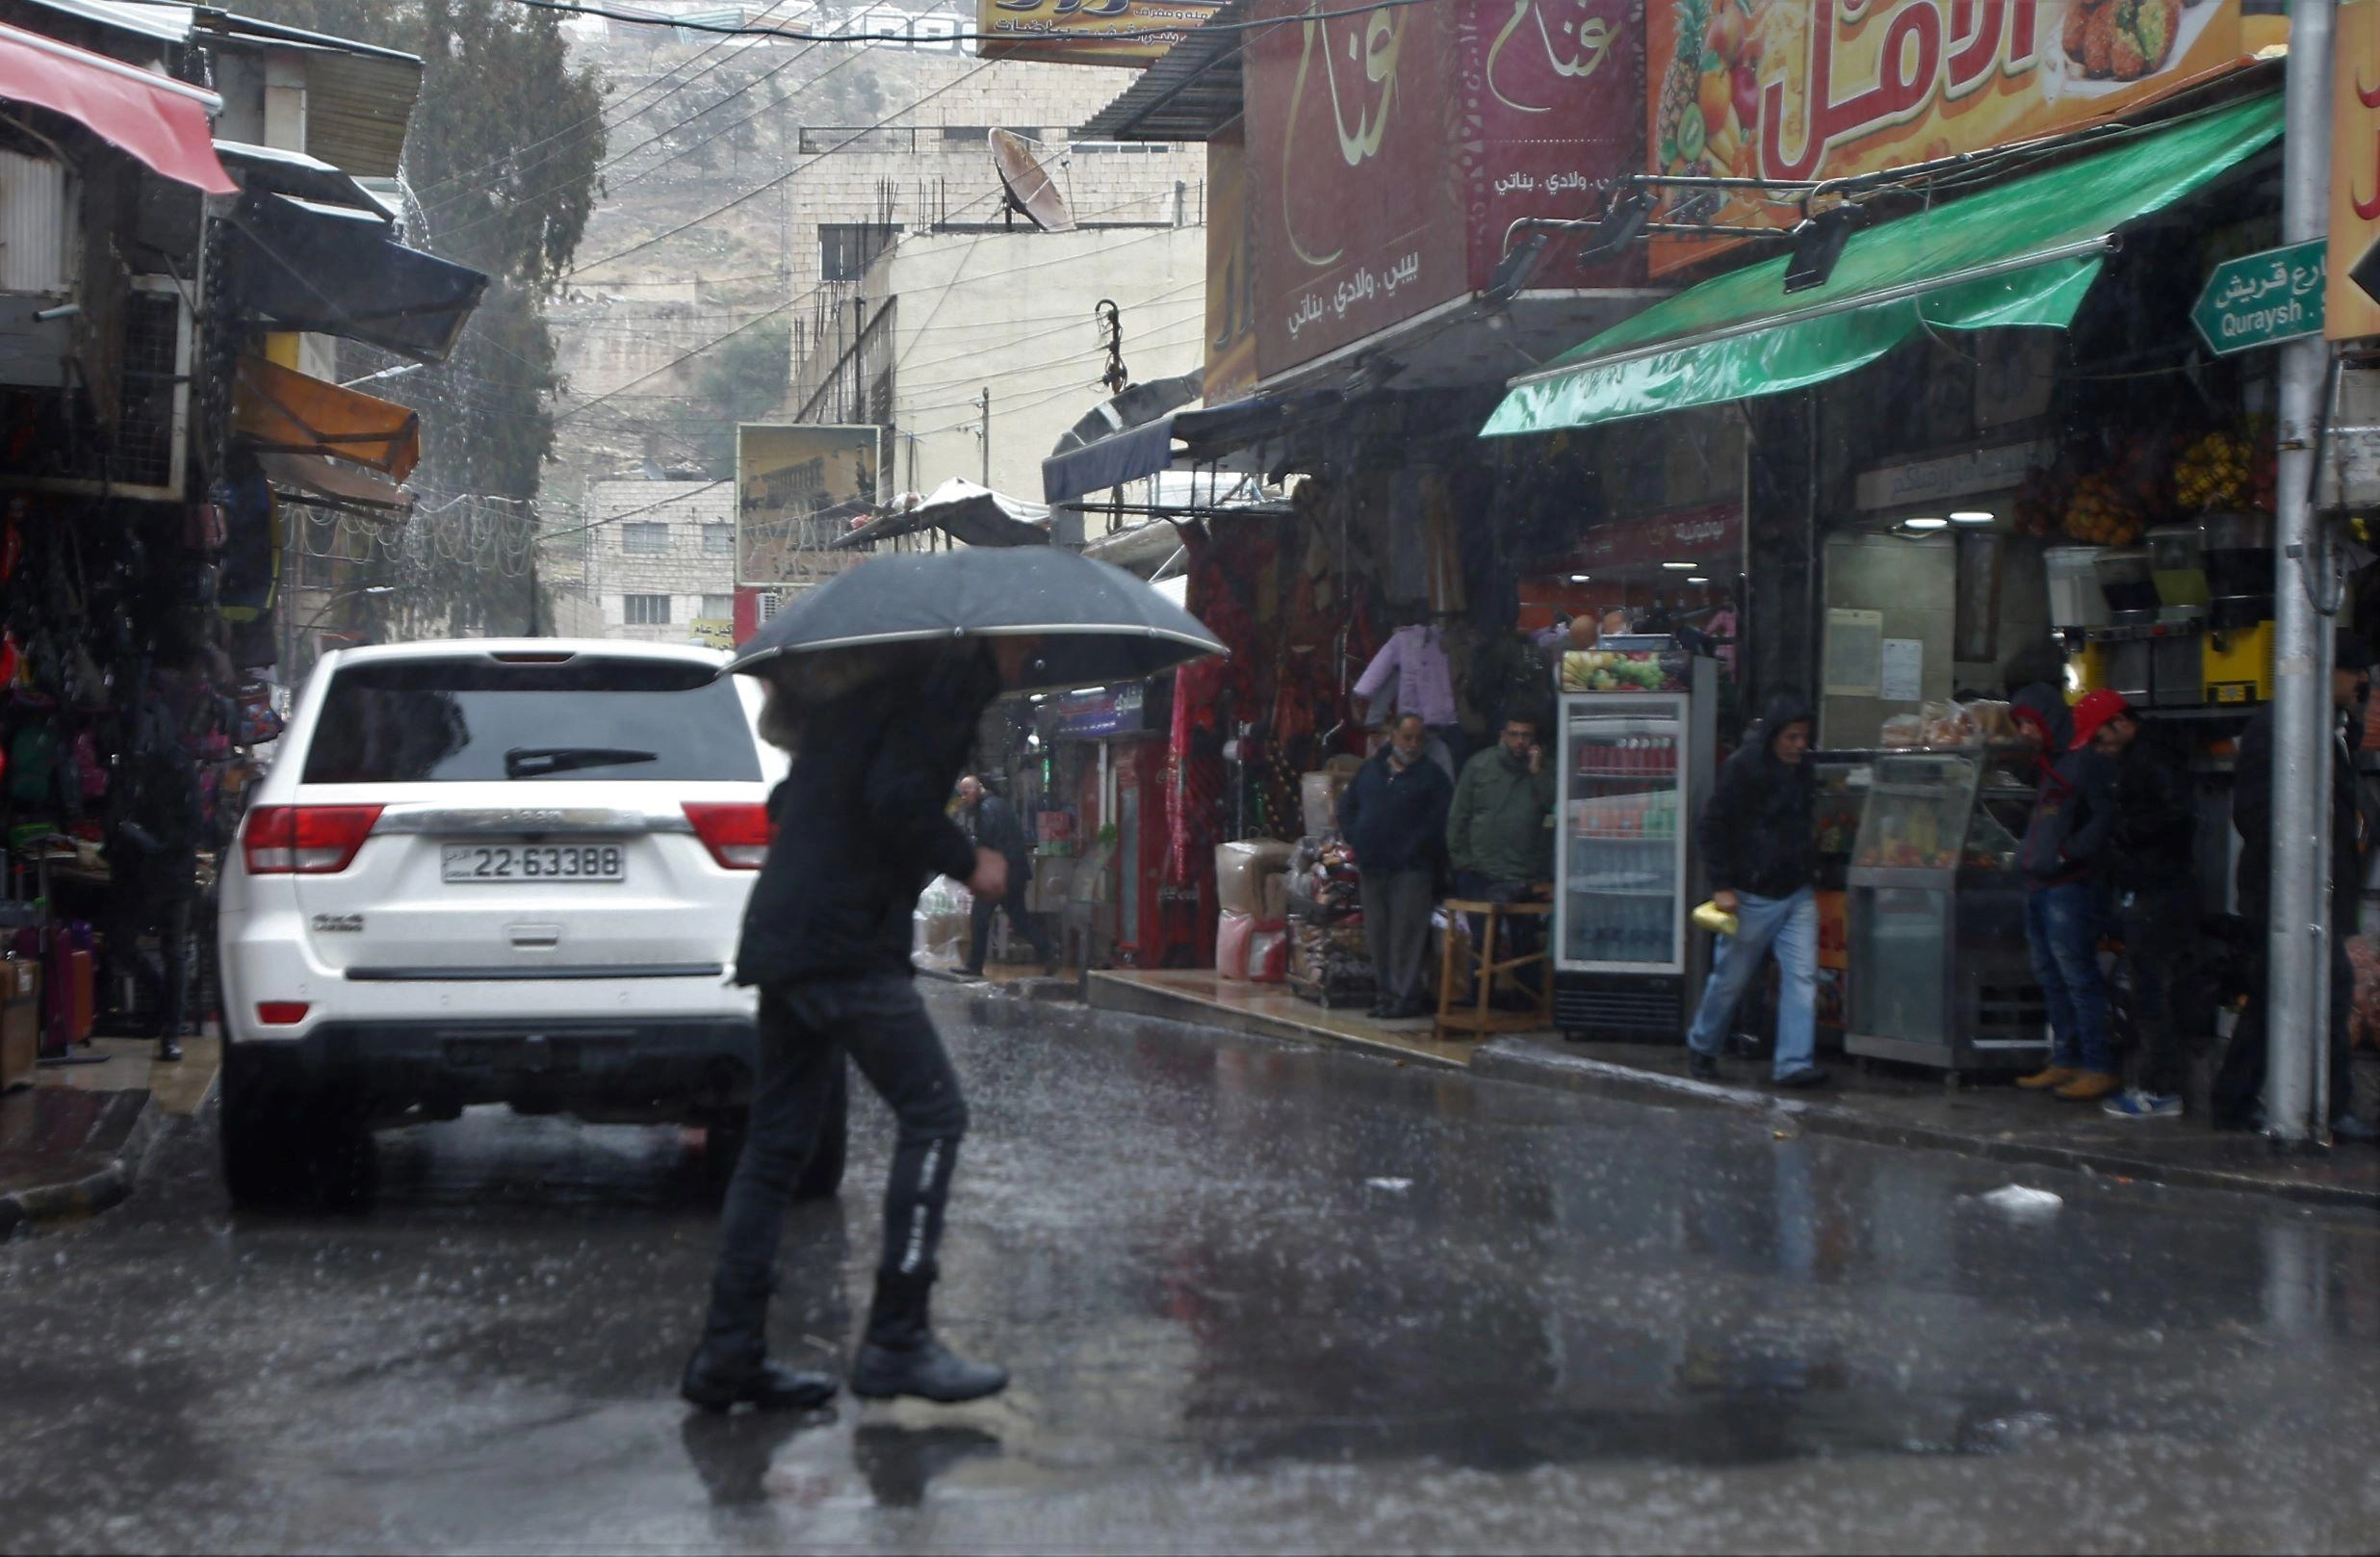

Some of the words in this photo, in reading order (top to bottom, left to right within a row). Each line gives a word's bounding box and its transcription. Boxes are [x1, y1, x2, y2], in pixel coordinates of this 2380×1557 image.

[1494, 171, 1534, 195] بناتي
[1545, 171, 1587, 195] ولادي
[1333, 267, 1374, 320] ولادي
[2215, 261, 2288, 309] قريش
[2292, 255, 2326, 296] ارع
[1288, 293, 1323, 340] بناتي
[2221, 298, 2302, 337] Quraysh
